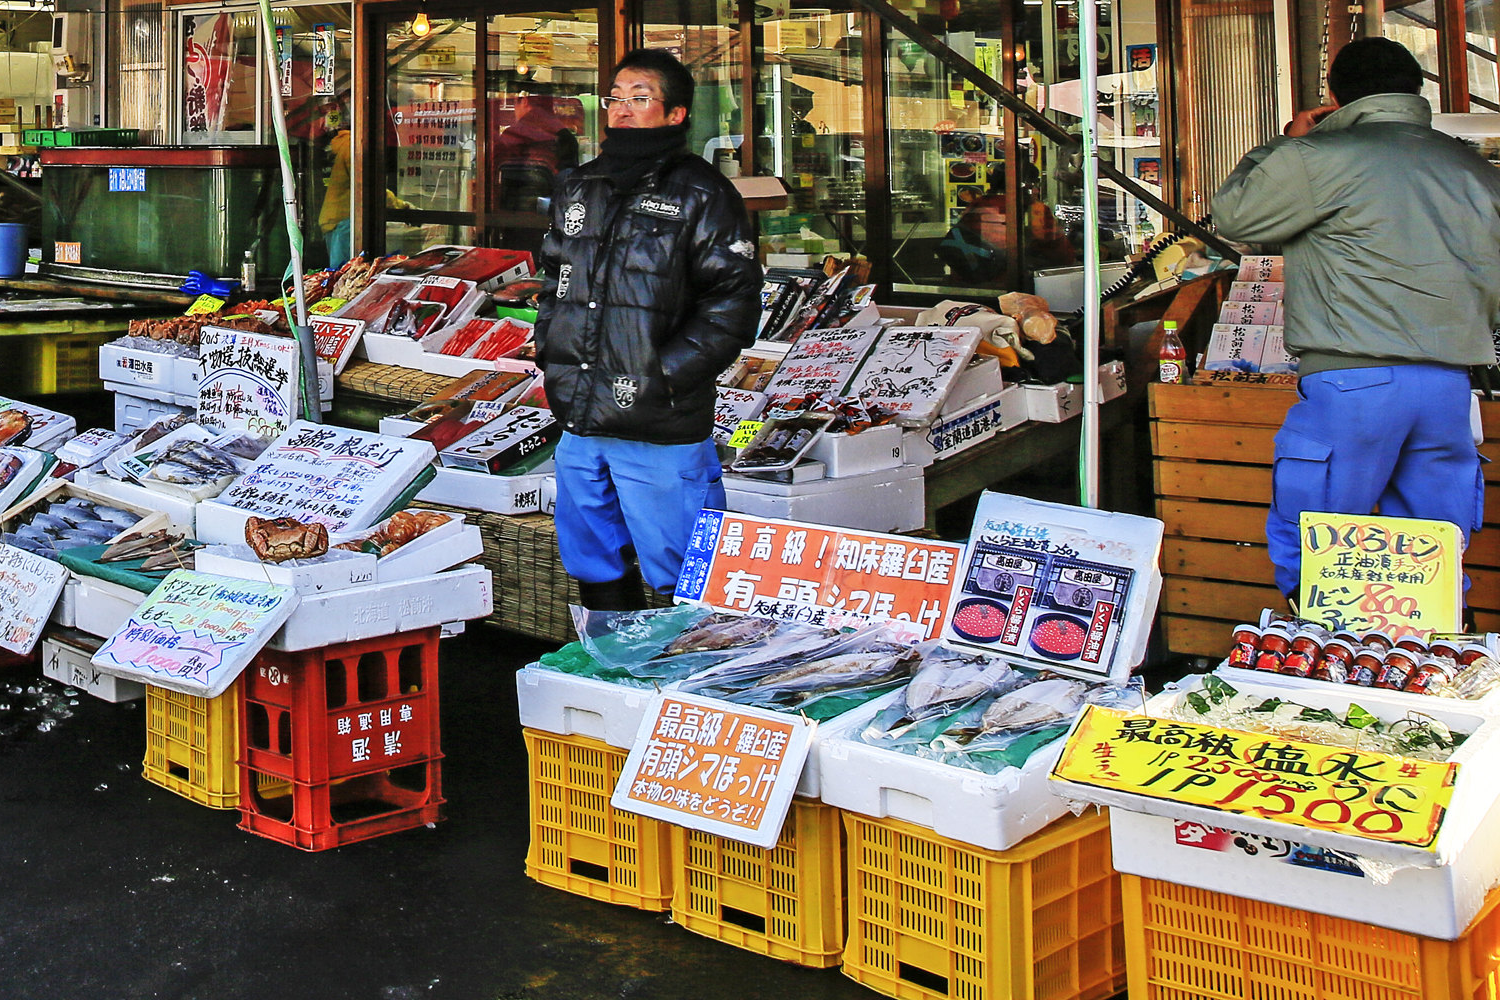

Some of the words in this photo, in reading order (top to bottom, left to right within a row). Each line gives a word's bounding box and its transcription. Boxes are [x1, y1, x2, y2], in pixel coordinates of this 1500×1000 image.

[200, 330, 220, 344] 2015
[519, 436, 541, 455] たらこ
[1307, 526, 1439, 557] いくらビン
[835, 537, 954, 584] 知床羅臼産
[734, 723, 788, 760] 羅臼産
[1111, 719, 1241, 762] 最高級
[640, 738, 777, 802] 有頭シマほっけ
